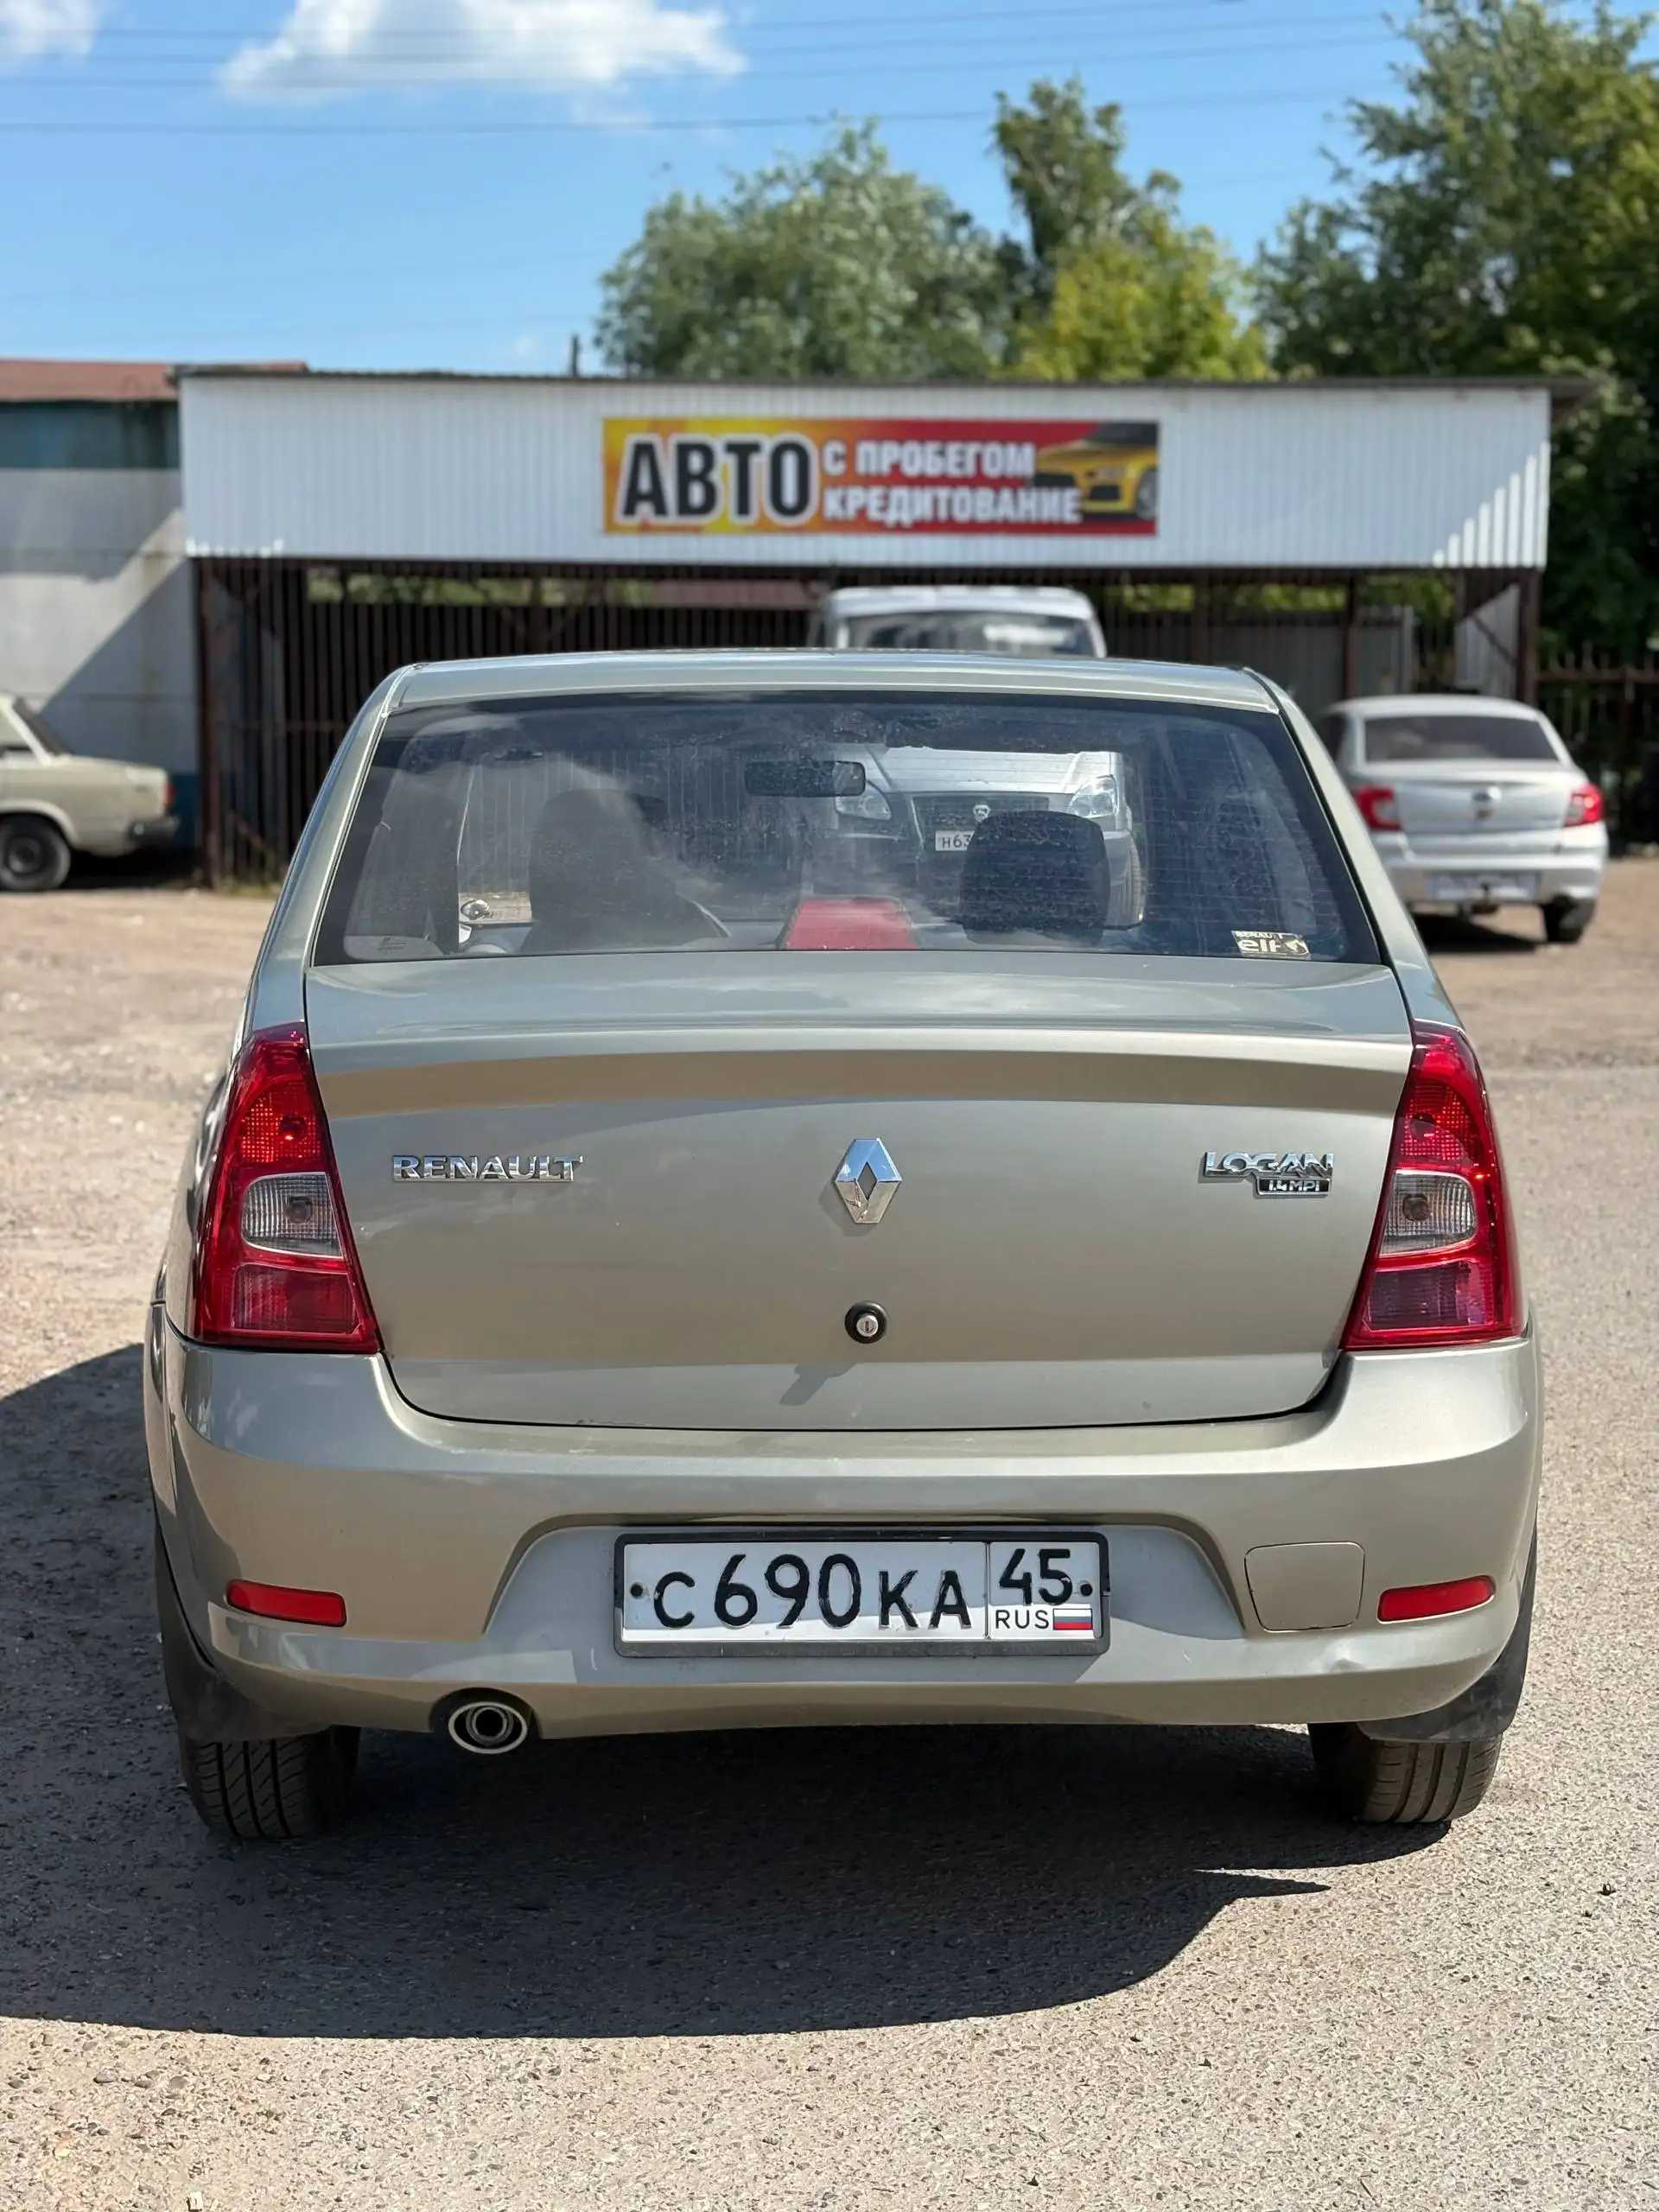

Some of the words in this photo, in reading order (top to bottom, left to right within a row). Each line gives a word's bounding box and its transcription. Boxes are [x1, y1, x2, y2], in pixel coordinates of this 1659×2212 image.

[823, 440, 848, 475] С
[855, 440, 1035, 478] ПРОБЕГОМ
[620, 437, 814, 521] АВТО
[824, 486, 1083, 527] КРЕДИТОВАНИЕ
[392, 1155, 583, 1181] RENAULT
[1204, 1152, 1334, 1178] LOGAN
[999, 1548, 1073, 1606] 45
[995, 1609, 1050, 1630] RUS
